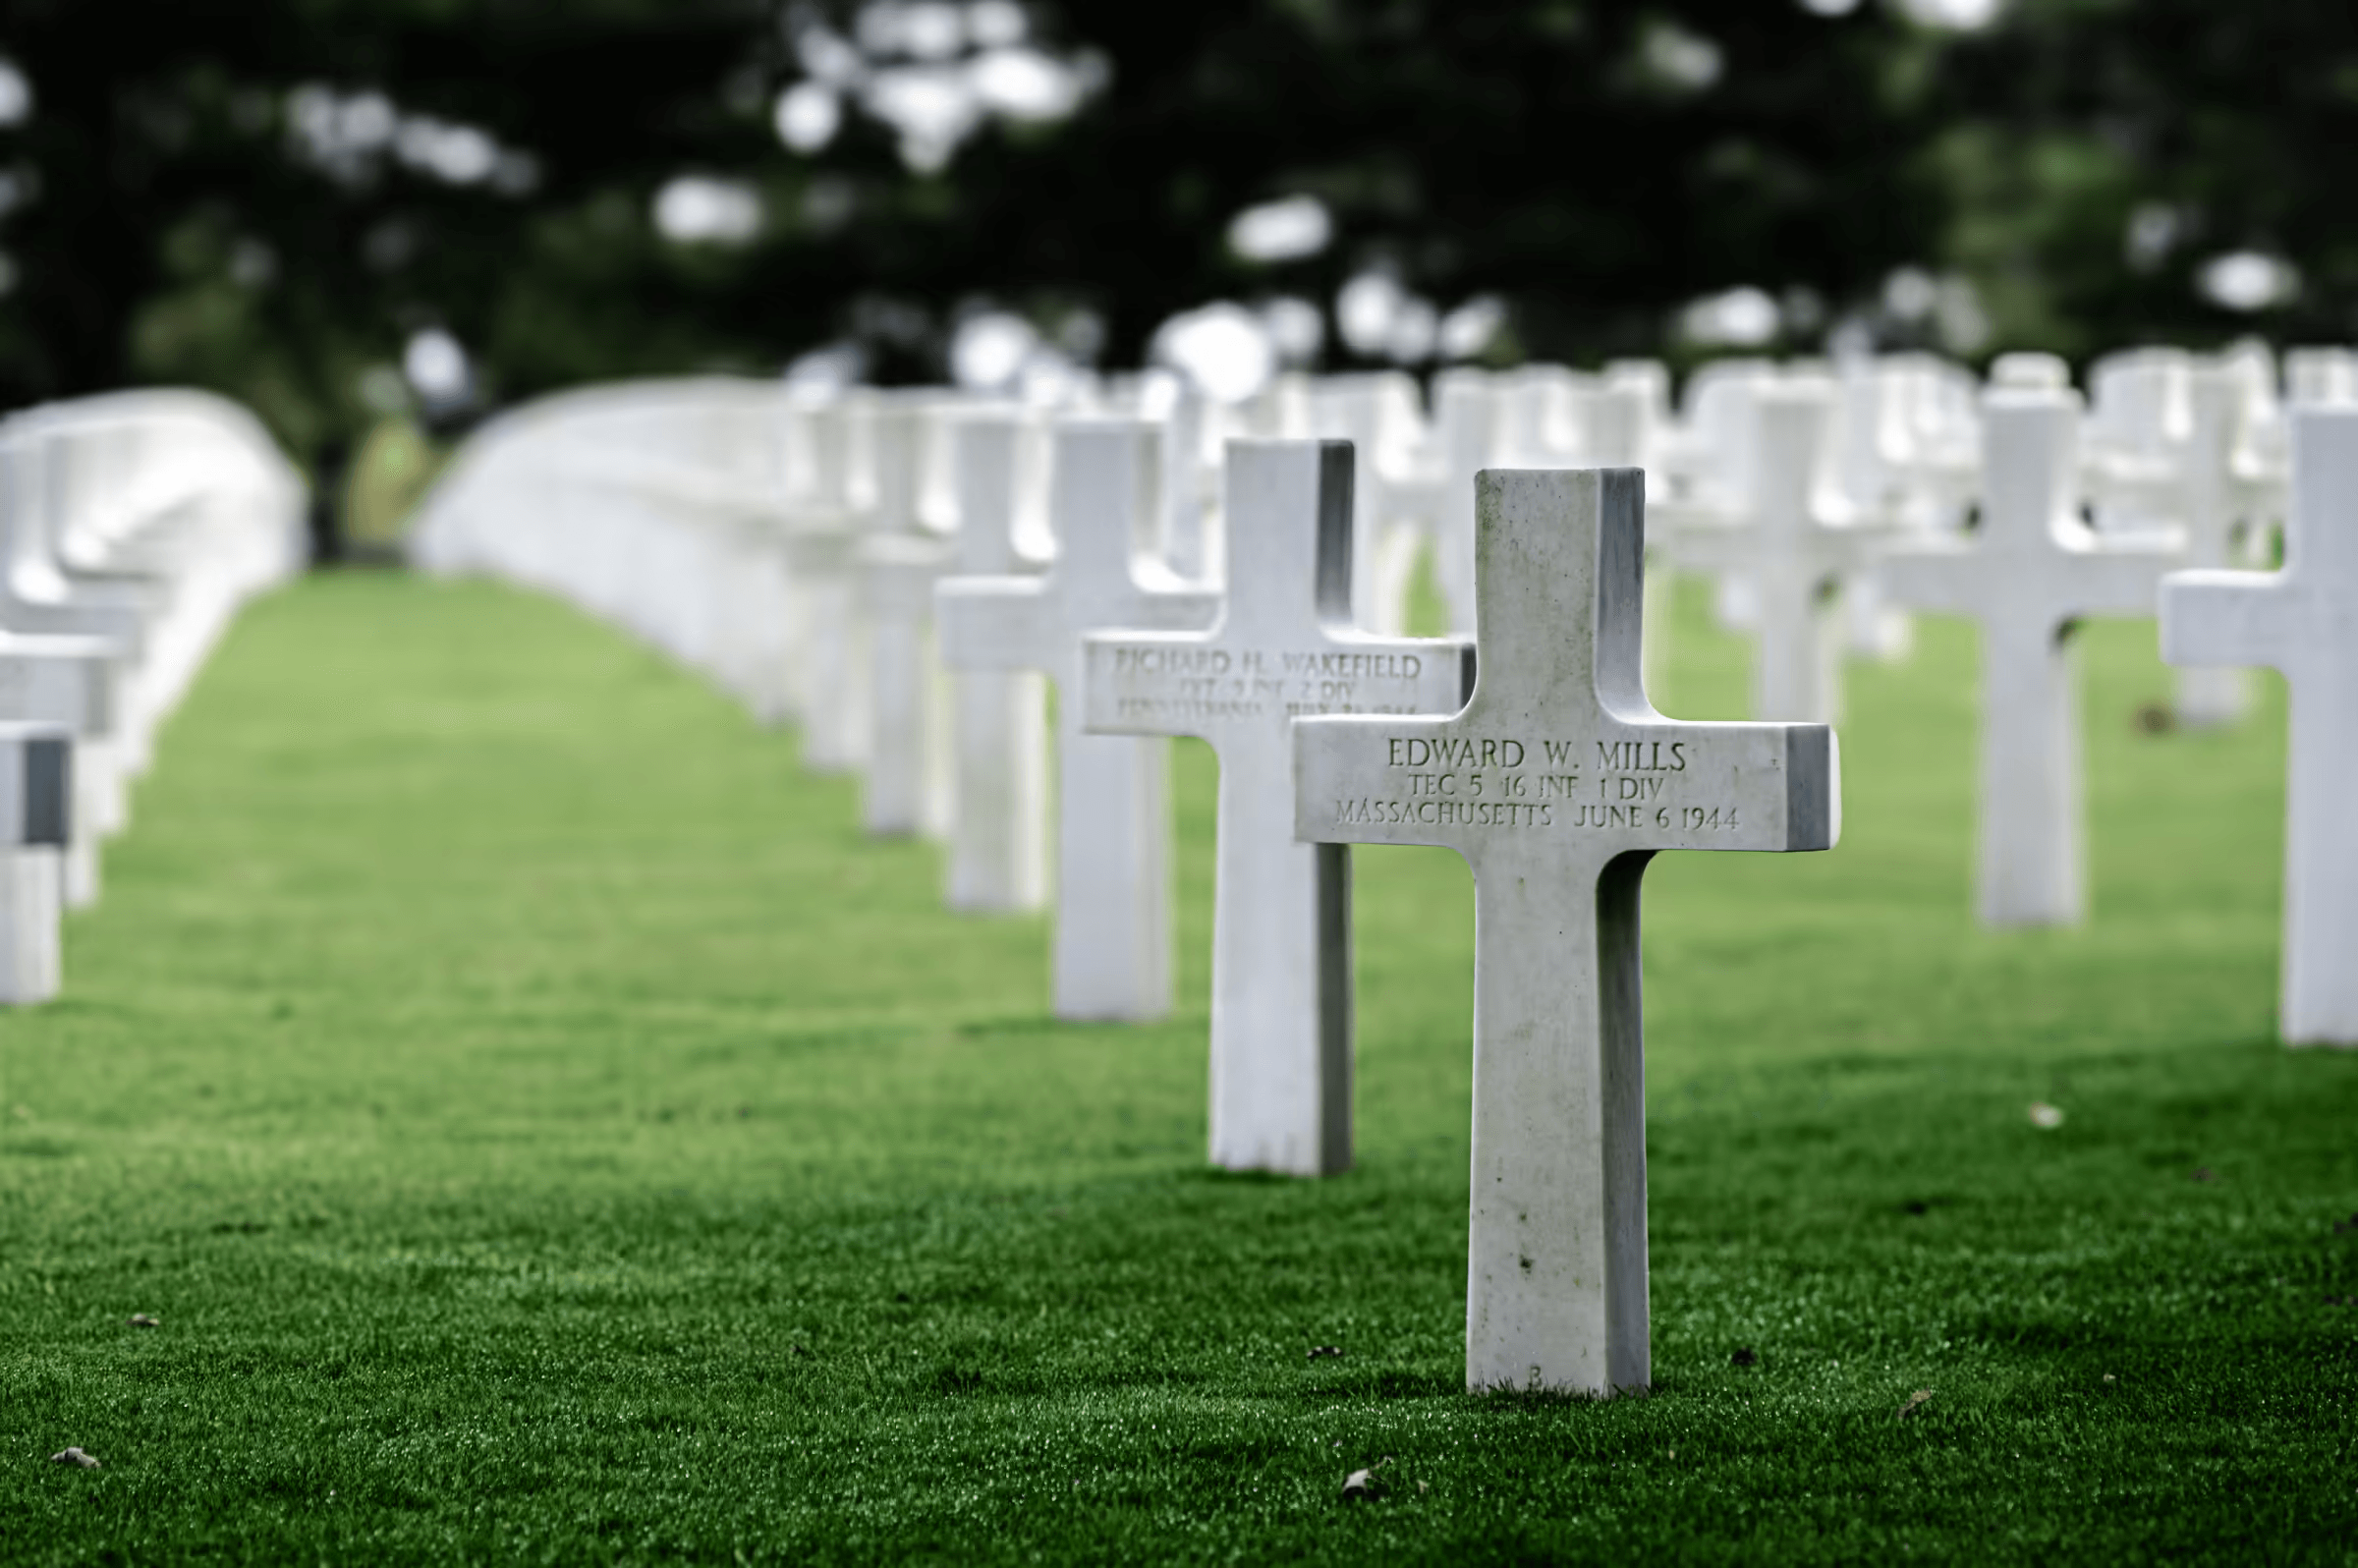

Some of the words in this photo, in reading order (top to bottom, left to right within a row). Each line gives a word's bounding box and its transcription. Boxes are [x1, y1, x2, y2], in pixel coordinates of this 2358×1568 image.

[1115, 647, 1231, 676] RICHARD
[1281, 650, 1423, 679] WAKEFIELD
[1320, 680, 1356, 701] DIV
[1387, 737, 1525, 768] EDWARD
[1543, 739, 1580, 769] W.
[1596, 741, 1687, 772] MILLS
[1408, 773, 1456, 796] TEC
[1470, 773, 1483, 797] 5
[1503, 773, 1527, 798] 16
[1539, 775, 1580, 799] INF
[1600, 777, 1607, 799] 1
[1619, 777, 1664, 801] DIV
[1335, 797, 1552, 826] MASSACHUSETTS
[1574, 805, 1643, 828] JUNE
[1655, 806, 1670, 829] 6
[1681, 806, 1741, 831] 1944
